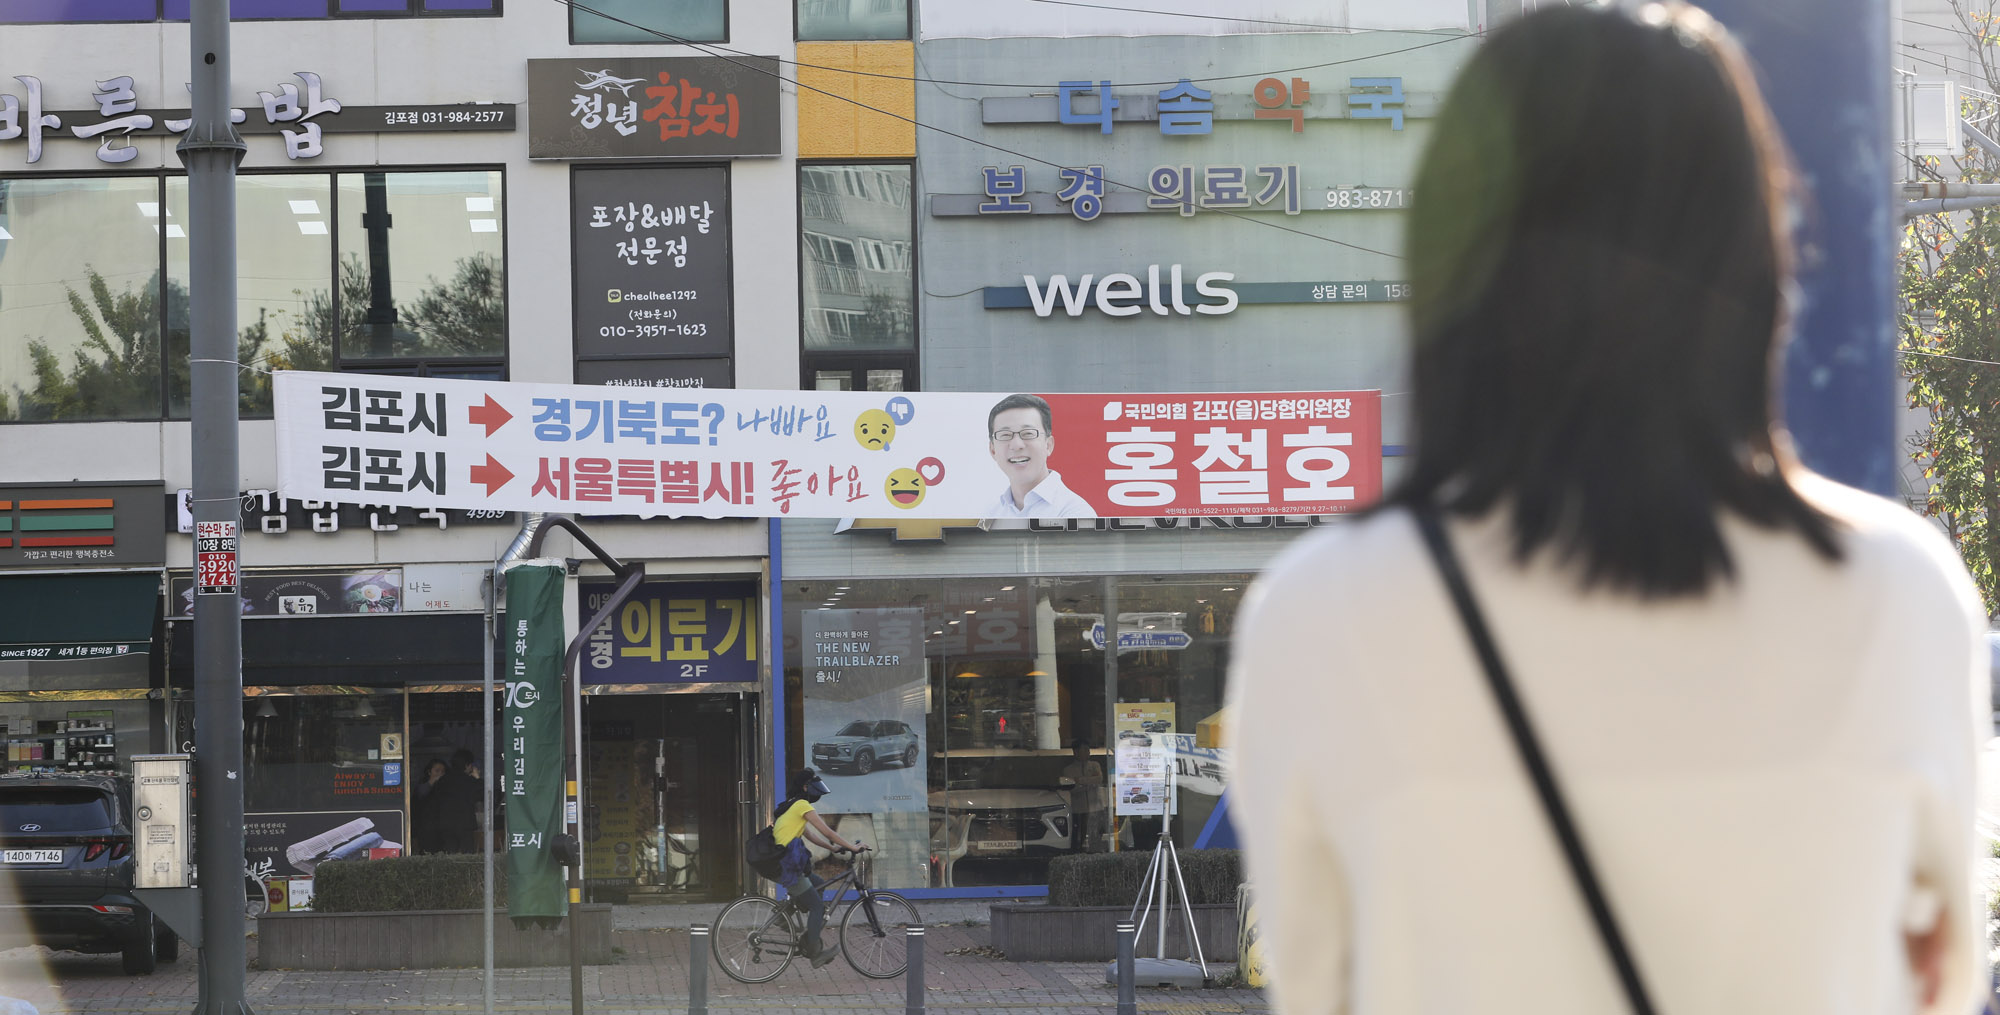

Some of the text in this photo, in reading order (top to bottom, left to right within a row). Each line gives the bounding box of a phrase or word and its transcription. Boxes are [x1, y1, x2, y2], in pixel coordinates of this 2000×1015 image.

[570, 71, 740, 142] 청년 참치
[385, 111, 504, 124] 김포점 031-984-2577
[1147, 163, 1301, 217] 의료기
[589, 200, 714, 234] 포장&배달
[616, 235, 687, 268] 전문점
[624, 290, 697, 301] cheolhee1292
[1023, 263, 1239, 317] wells
[1311, 284, 1338, 299] 상담
[1341, 284, 1367, 298] 문의
[600, 323, 707, 338] 010-3957-1623
[321, 386, 837, 446] 김포시 경기북도? 나빠요
[1124, 398, 1352, 421] 국민의힘 김포(을)당협위원장
[1104, 425, 1356, 508] 홍철호
[321, 445, 868, 514] 김포시 서울특별시! 좋아요
[198, 523, 236, 538] 현수막 5m
[199, 538, 236, 551] 10장 8만
[50, 550, 73, 559] 편리한
[199, 560, 236, 573] 5920
[199, 573, 237, 586] 4747
[409, 582, 432, 593] 나는
[425, 600, 451, 608] 어제도
[620, 597, 757, 662] 의료기
[26, 648, 51, 657] 1927
[815, 642, 871, 654] THE NEW
[815, 655, 900, 667] TRAILBLAZER
[680, 663, 708, 678] 2F
[815, 670, 842, 683] 출시!
[5, 850, 60, 862] 140하 7146
